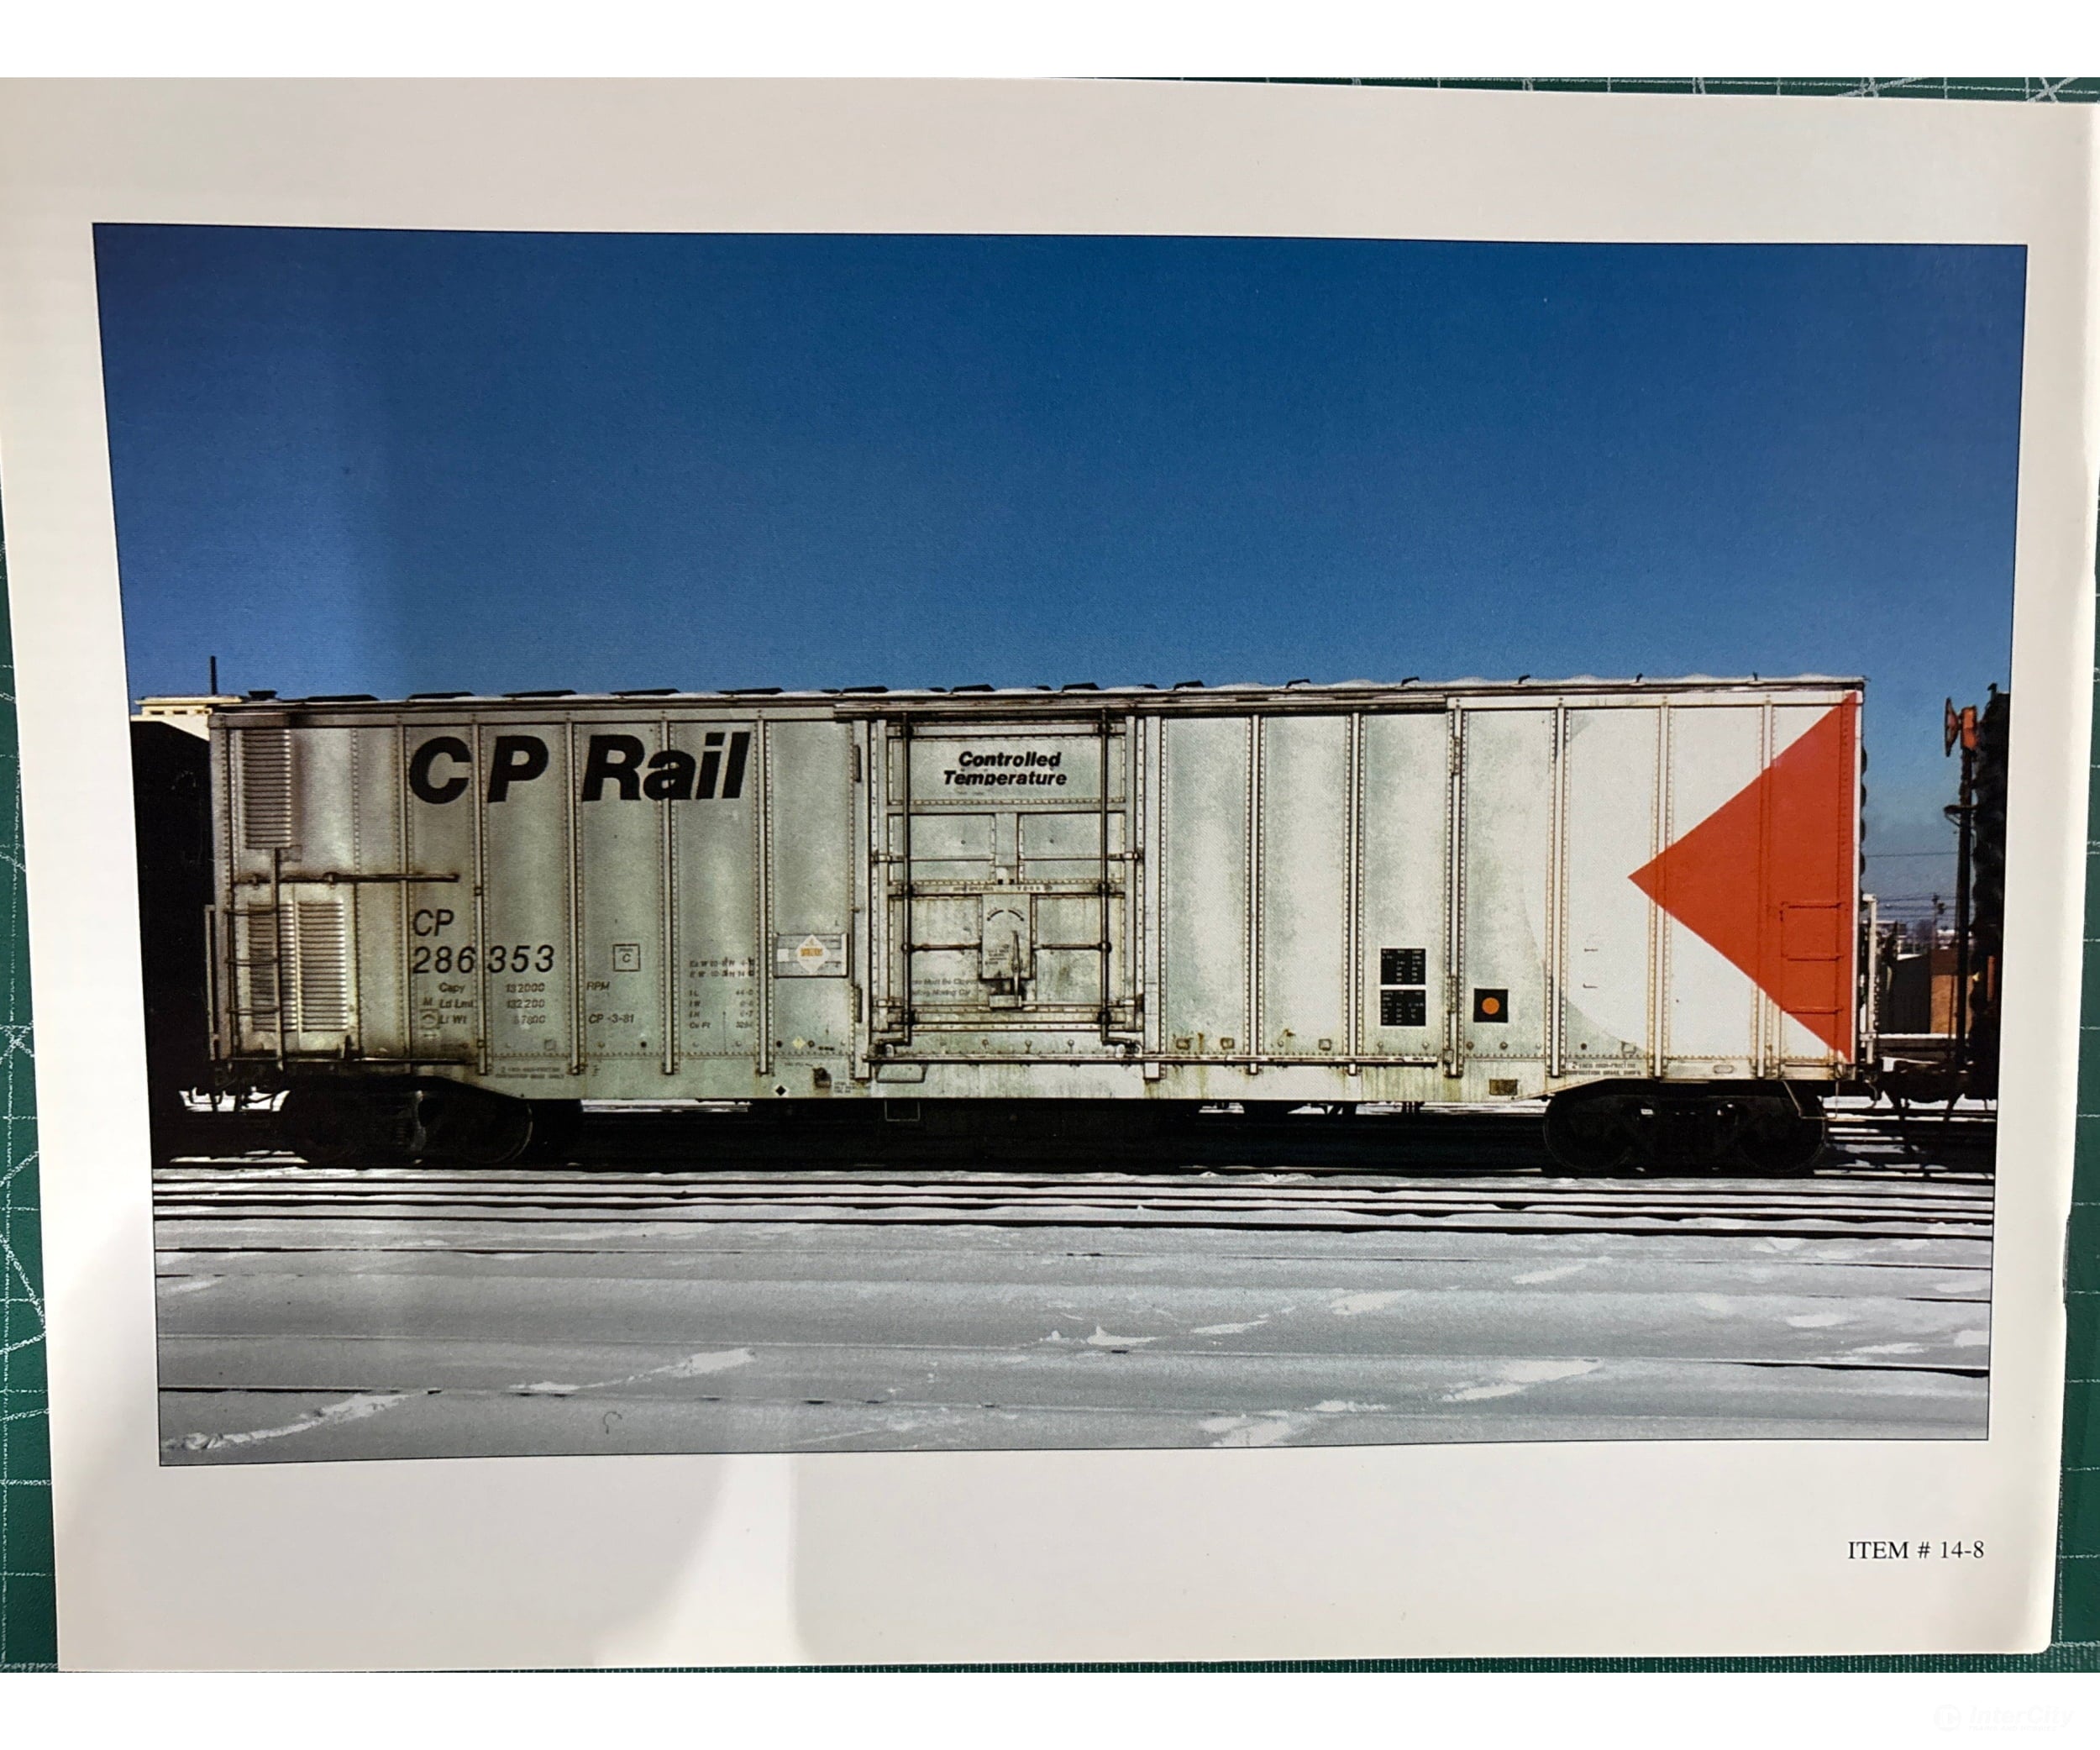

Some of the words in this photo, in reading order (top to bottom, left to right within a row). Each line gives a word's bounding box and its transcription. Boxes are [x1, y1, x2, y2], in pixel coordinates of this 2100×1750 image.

[582, 732, 751, 801] Rail
[958, 751, 1062, 767] Controlled
[943, 770, 1068, 786] Temperature
[412, 909, 454, 937] CP
[412, 944, 554, 974] 286353
[622, 953, 631, 963] C
[586, 981, 611, 991] RPM
[588, 1013, 604, 1023] CP
[1848, 1541, 1909, 1559] ITEM
[1917, 1541, 1930, 1558] #
[1940, 1540, 1984, 1558] 14-8
